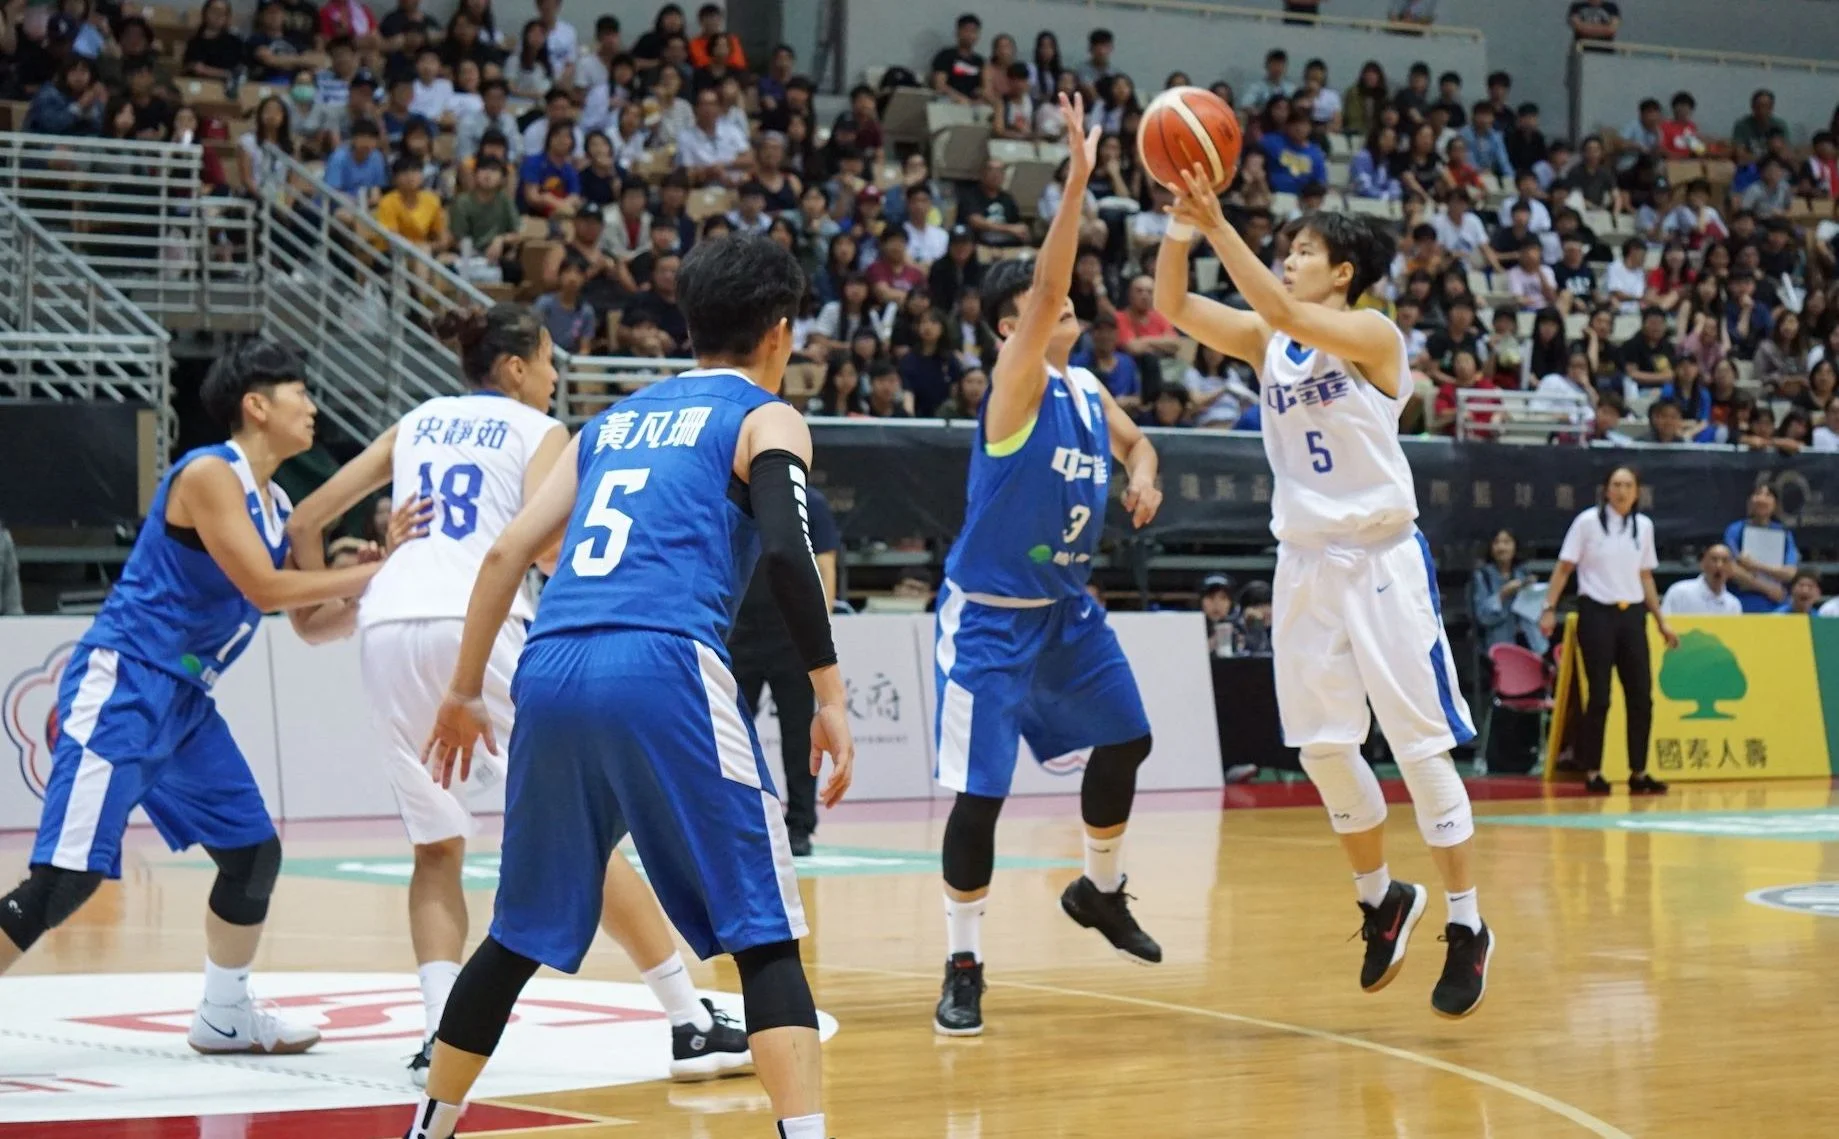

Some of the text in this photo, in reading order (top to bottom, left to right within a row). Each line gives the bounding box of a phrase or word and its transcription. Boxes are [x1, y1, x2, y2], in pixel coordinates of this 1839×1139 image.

[593, 406, 713, 455] 黃凡珊
[1305, 431, 1333, 474] 5
[418, 462, 484, 541] 18
[571, 468, 651, 577] 5
[1062, 504, 1091, 543] 3
[1655, 738, 1768, 770] 國泰人壽
